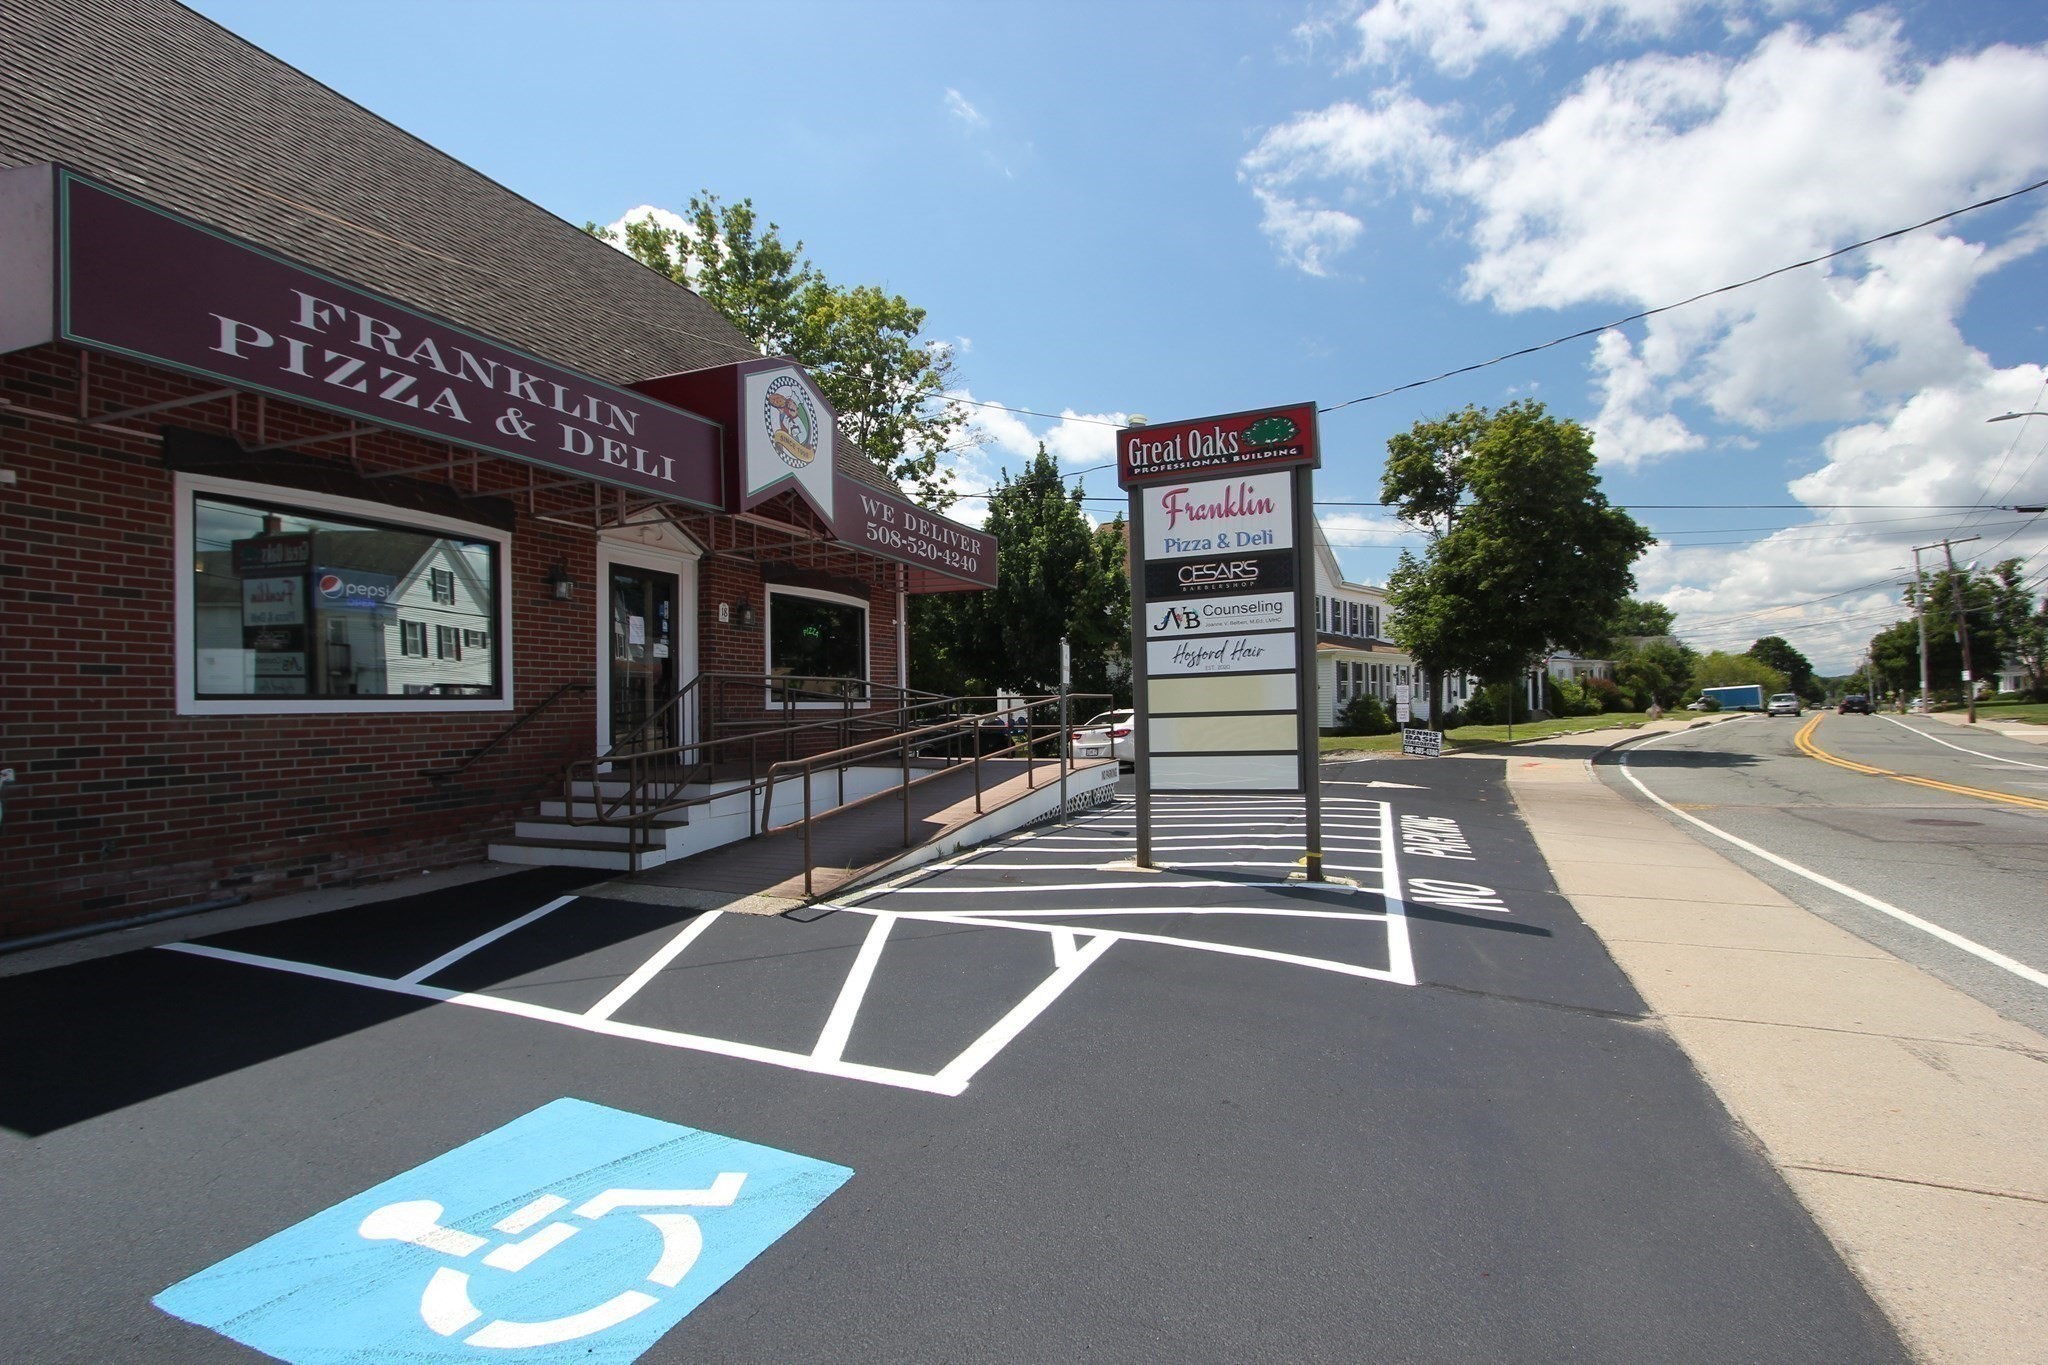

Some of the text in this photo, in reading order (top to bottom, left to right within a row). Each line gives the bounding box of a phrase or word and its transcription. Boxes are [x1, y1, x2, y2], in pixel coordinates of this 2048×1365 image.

[290, 288, 640, 436] FRANKLIN
[209, 312, 676, 483] PIZZA & DELI
[780, 434, 796, 450] SINCE
[1128, 426, 1239, 467] Great Oaks
[1134, 448, 1297, 474] PROFESSIONAL BUILDING
[1162, 482, 1275, 530] Franklin
[859, 494, 981, 556] WE DELIVER
[866, 521, 977, 573] 508-520-4240
[1164, 529, 1273, 553] Pizza & Deli
[1178, 560, 1259, 583] CESAR'S
[346, 583, 390, 599] pepsi
[1182, 581, 1254, 592] BARBERSHOP
[721, 607, 728, 618] 18
[1203, 601, 1283, 617] Counseling
[803, 627, 819, 638] PIZZA
[1172, 638, 1265, 668] Hosford Hair
[1405, 729, 1439, 738] DENNIS
[1405, 735, 1440, 743] BASIC
[1400, 815, 1511, 913] NO PARKING
